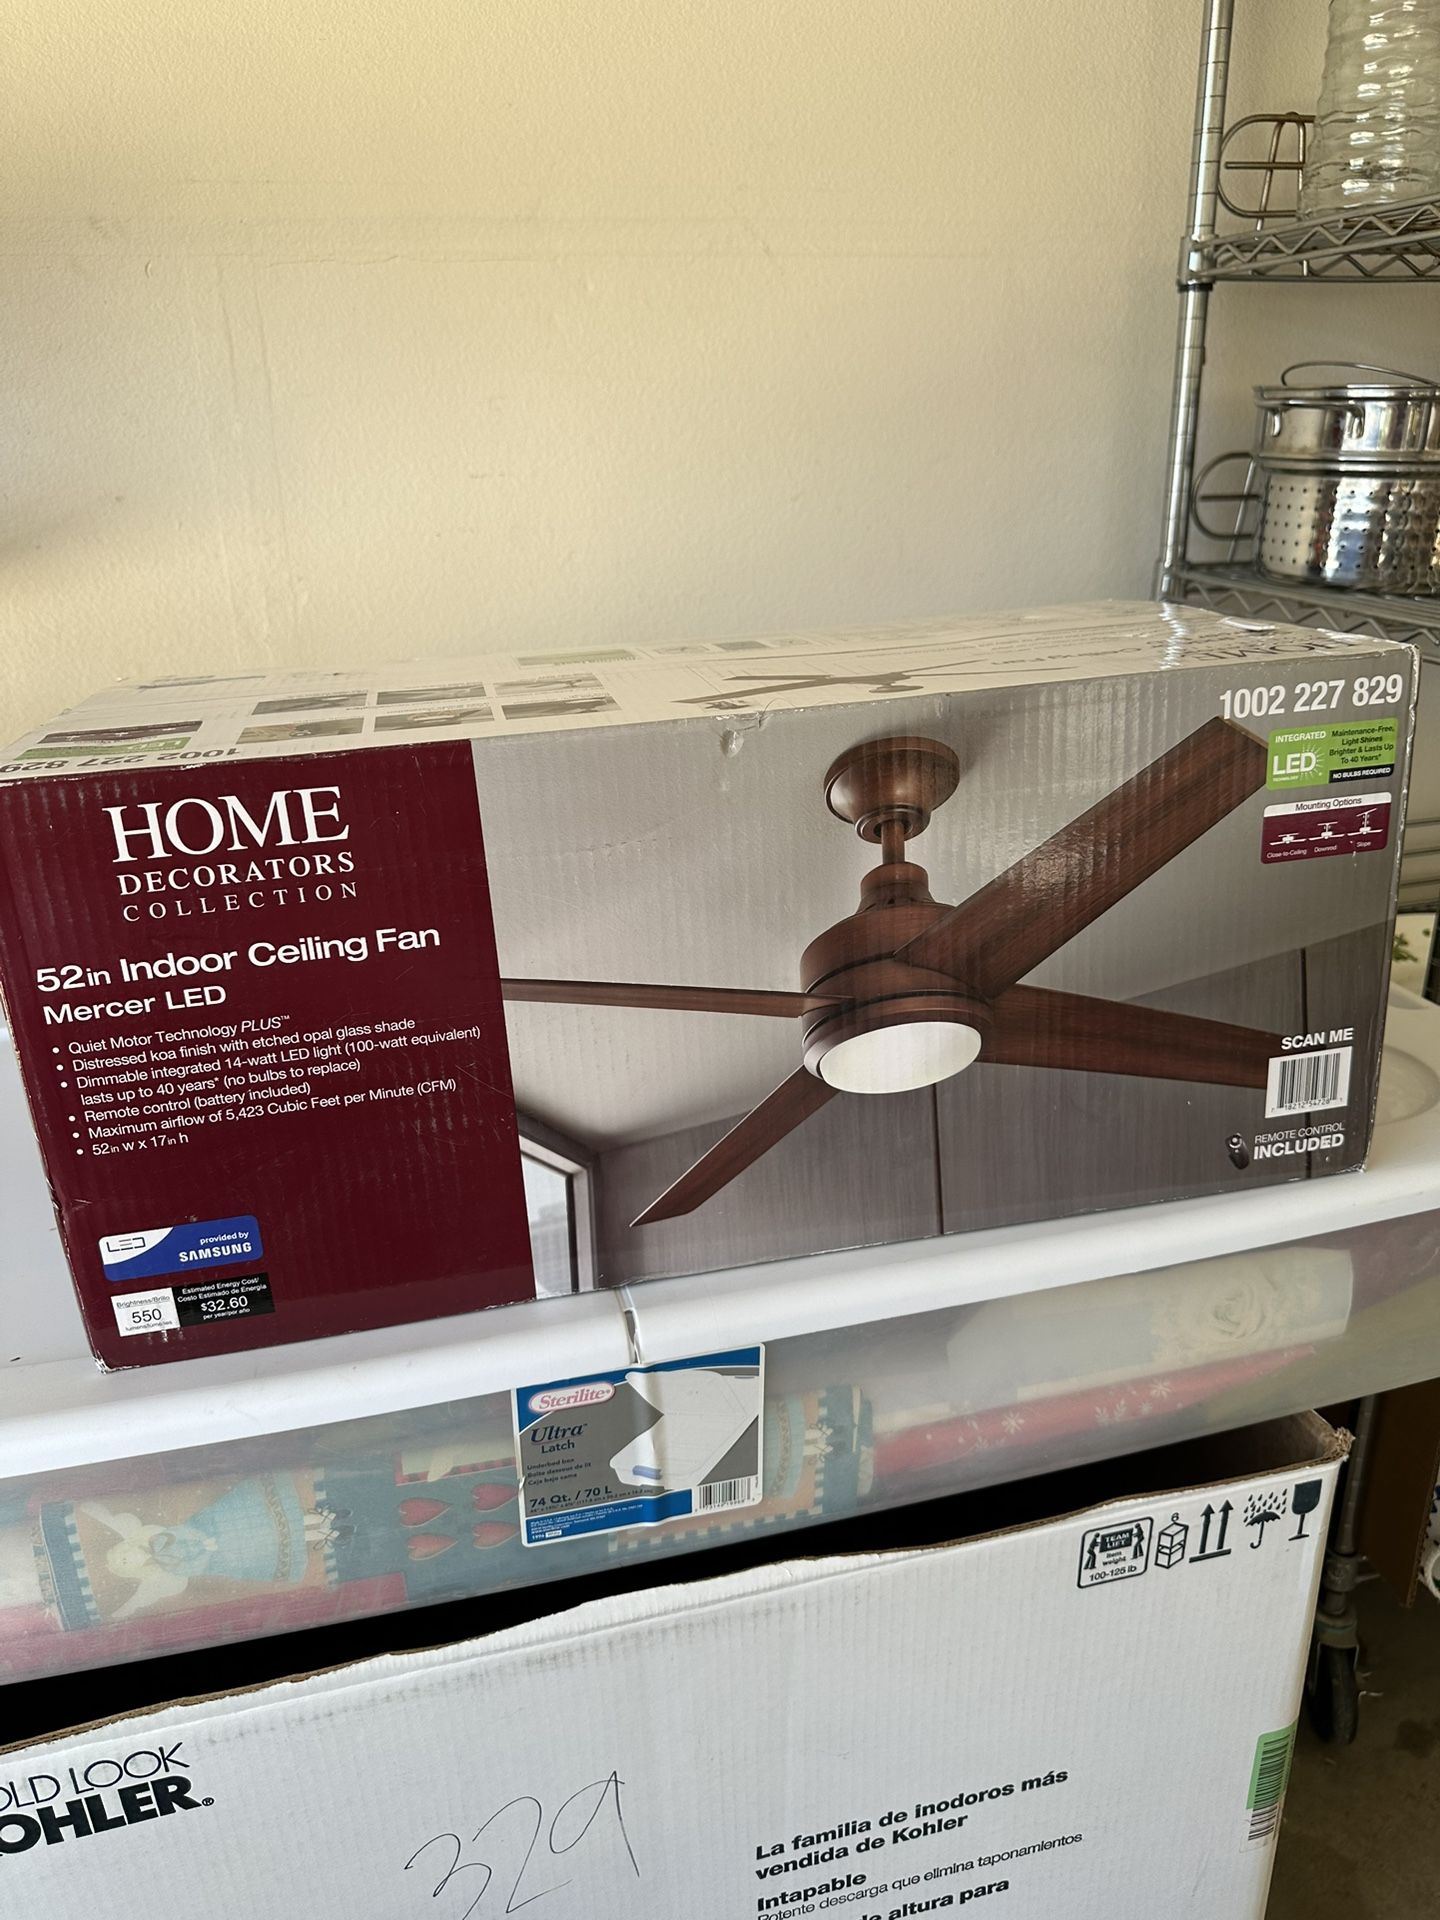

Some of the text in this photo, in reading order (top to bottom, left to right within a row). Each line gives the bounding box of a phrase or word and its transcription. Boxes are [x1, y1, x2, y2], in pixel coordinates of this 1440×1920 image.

[1219, 673, 1403, 720] 1002 227 829
[1275, 730, 1327, 743] INTEGRATED
[1341, 735, 1384, 747] Light Shines
[77, 754, 148, 768] 227
[157, 747, 240, 762] 1002
[1329, 747, 1357, 758] Brighter
[1364, 744, 1383, 752] Lasts
[1384, 743, 1395, 752] Up
[1340, 757, 1349, 765] To
[1349, 755, 1359, 764] 40
[1272, 752, 1317, 775] LED
[1332, 767, 1392, 780] NO BULBS REQUIRED
[1295, 796, 1362, 812] Mounting Options
[102, 785, 350, 863] HOME
[117, 851, 355, 896] DECORATORS
[123, 882, 358, 921] COLLECTION
[36, 927, 441, 992] 52in Indoor Ceiling Fan
[43, 985, 227, 1025] Mercer LED
[68, 1040, 107, 1055] Quiet
[110, 1034, 153, 1049] Motor
[155, 1023, 237, 1044] Technology
[72, 1018, 416, 1072] Distressed koa finish with etched opal glass shade
[1281, 1027, 1354, 1050] SCAN ME
[76, 1026, 481, 1089] Dimmable integrated 14-watt LED light (100-watt equivalent)
[81, 1091, 114, 1106] lasts
[117, 1089, 136, 1103] up
[138, 1087, 153, 1098] to
[156, 1083, 175, 1096] 40
[223, 1074, 246, 1089] (no
[249, 1069, 287, 1084] bulbs
[290, 1065, 304, 1078] to
[307, 1058, 361, 1079] replace)
[84, 1082, 311, 1123] Remote control (battery included)
[88, 1078, 456, 1140] Maximum airflow of 5,423 Cubic Feet per Minute (CFM)
[92, 1132, 189, 1156] 52in w x 17in h
[1254, 1122, 1346, 1144] REMOTE CONTROL
[1253, 1133, 1344, 1160] INCLUDED
[106, 1236, 146, 1253] LED
[200, 1230, 250, 1245] provided by
[178, 1242, 252, 1263] SAMSUNG
[177, 1294, 198, 1303] Costo
[198, 1289, 230, 1300] Estimado
[231, 1287, 240, 1295] de
[182, 1284, 215, 1295] Estimated
[216, 1279, 241, 1291] Energy
[200, 1295, 249, 1313] $32.60
[132, 1308, 162, 1324] 550
[203, 1313, 213, 1321] per
[541, 1440, 575, 1454] Latch
[527, 1460, 560, 1471] Underbed
[530, 1498, 546, 1508] 74
[550, 1494, 571, 1504] Qt.
[575, 1489, 581, 1500] /
[584, 1487, 601, 1498] 70
[604, 1485, 612, 1495] L
[1104, 1532, 1130, 1543] TEAM
[1106, 1539, 1126, 1549] LIFT
[1089, 1565, 1137, 1581] 100-125 lb
[69, 1742, 190, 1794] LOOK
[756, 1770, 1069, 1860] La familia de inodoros más
[755, 1815, 968, 1880] vendida de Kohler
[819, 1883, 888, 1909] descarga
[892, 1875, 921, 1891] que
[924, 1861, 974, 1882] elimina
[977, 1833, 1083, 1868] taponamientos
[757, 1873, 867, 1912] Intapable
[888, 1880, 1009, 1920] altura para
